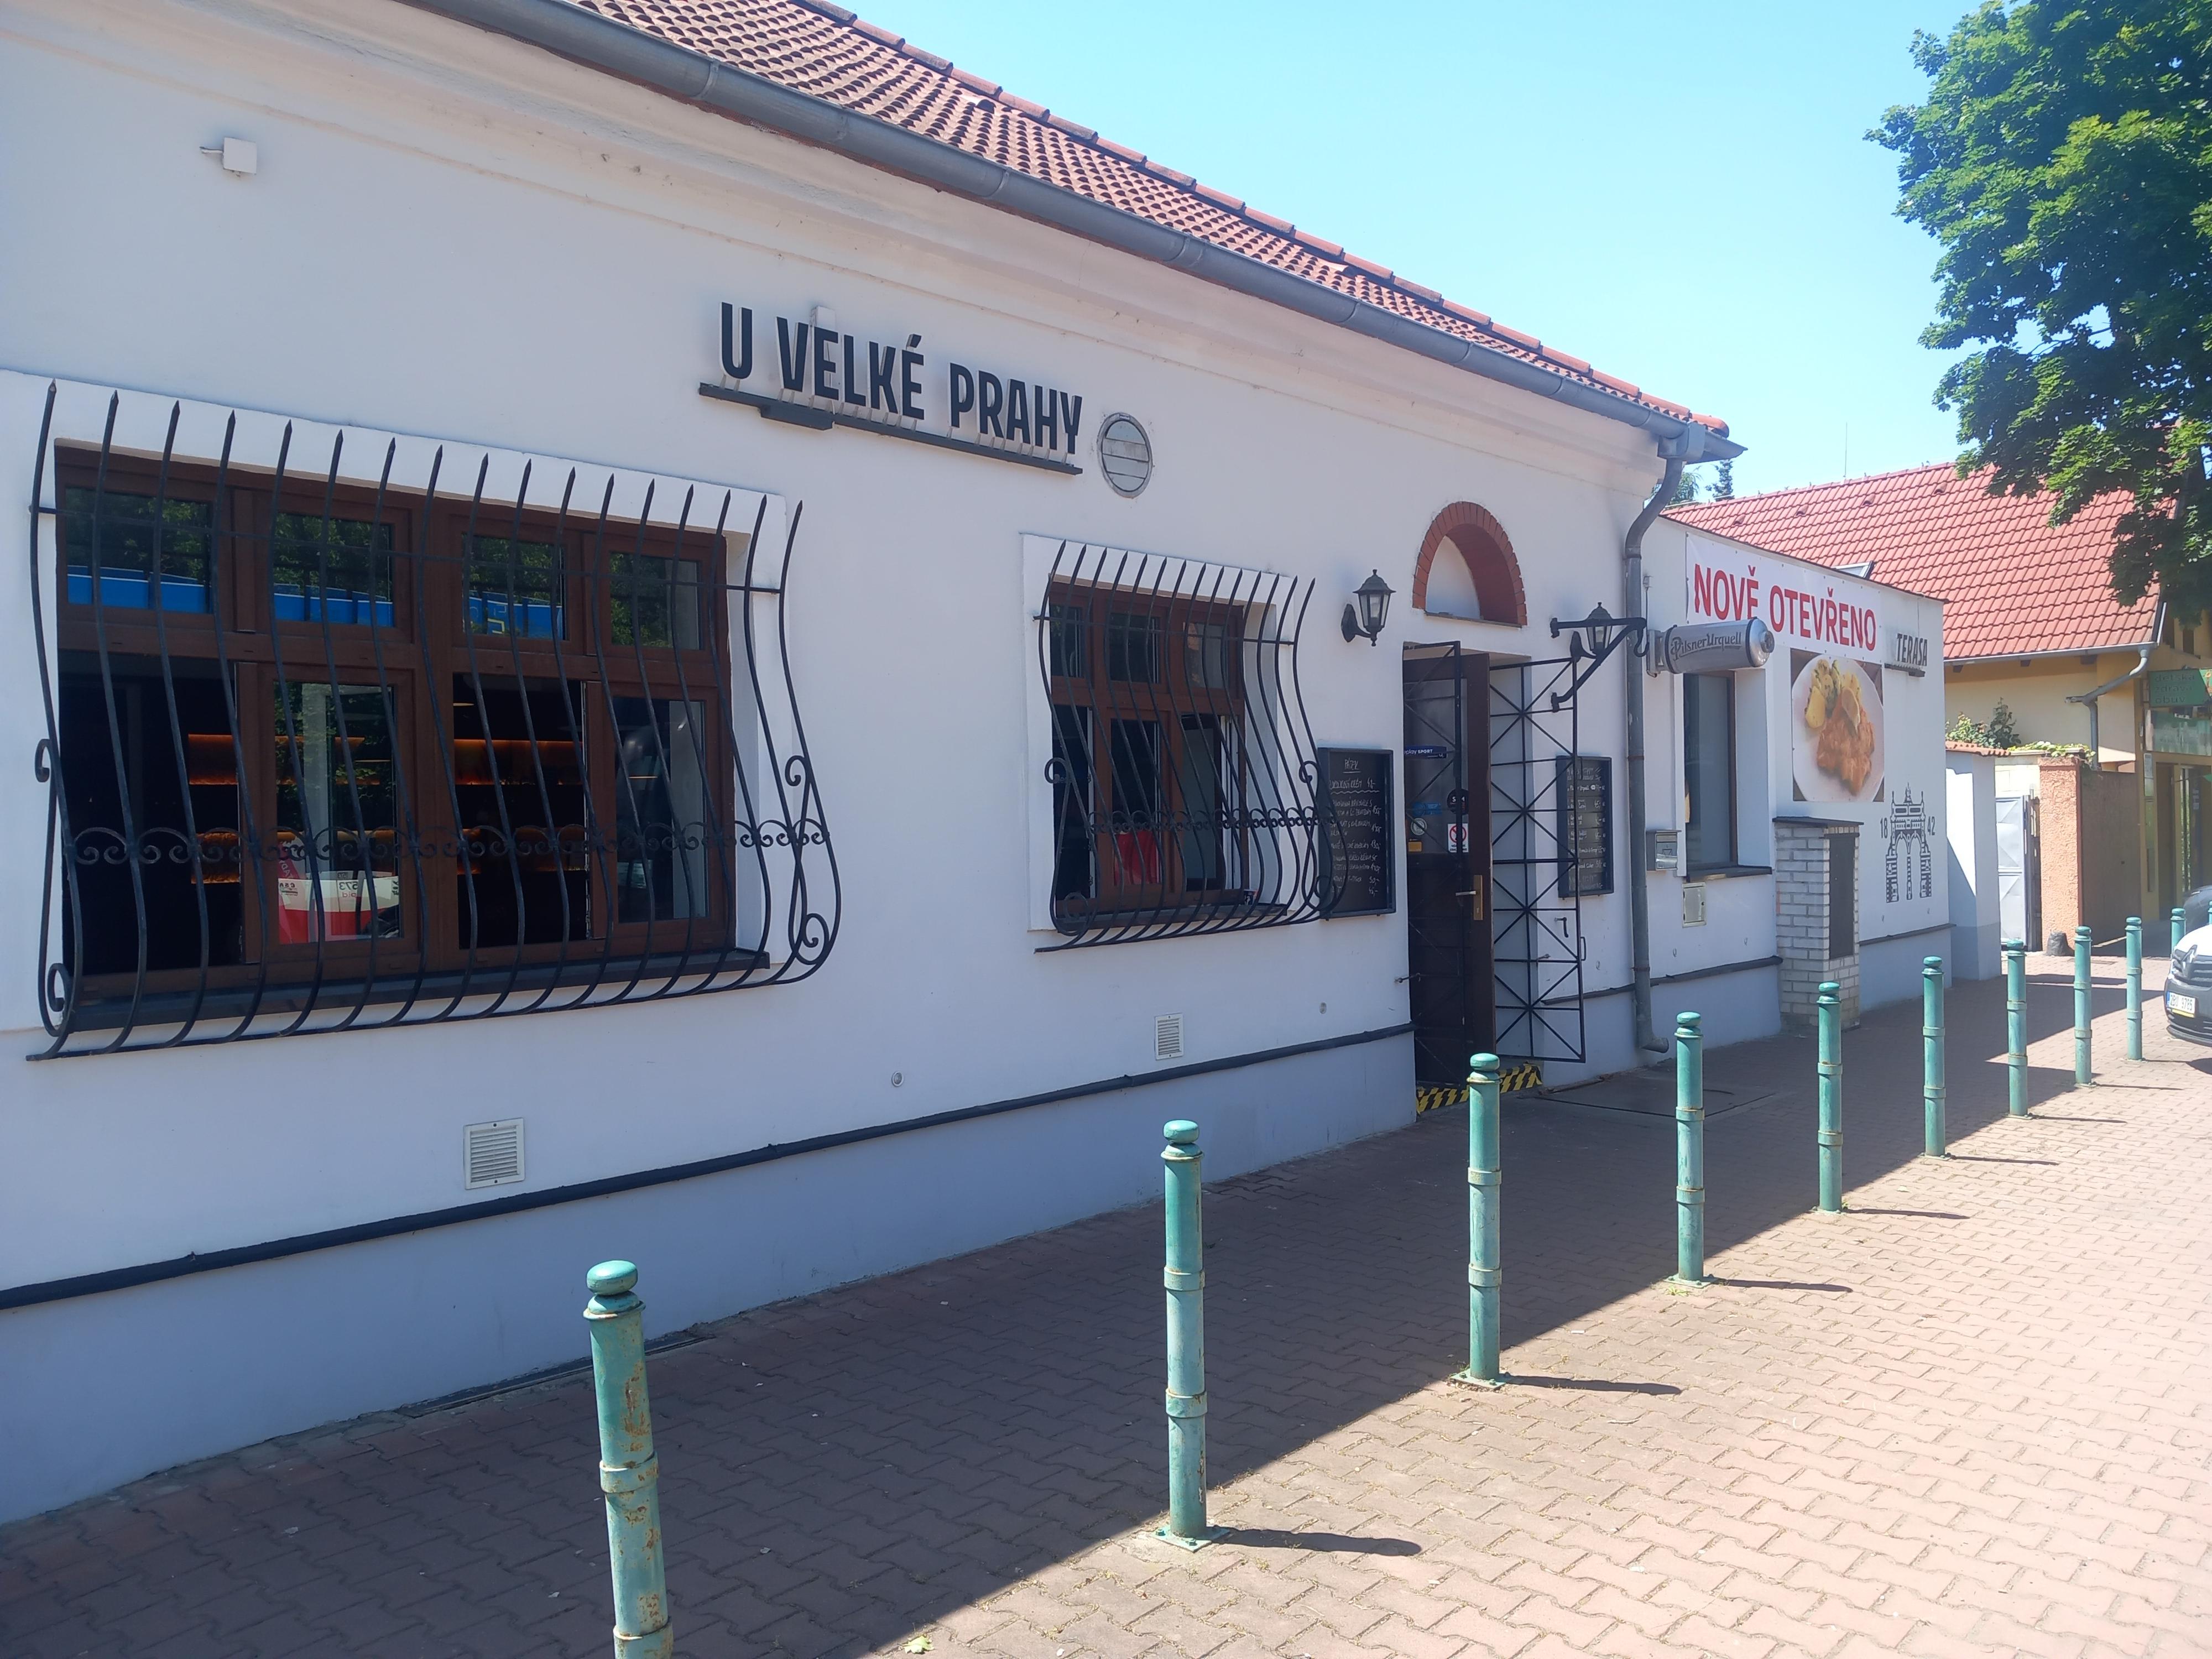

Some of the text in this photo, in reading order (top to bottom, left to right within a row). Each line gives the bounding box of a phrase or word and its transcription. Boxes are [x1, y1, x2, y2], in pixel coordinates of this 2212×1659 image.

[720, 301, 1083, 455] U VELKÉ PRAHY
[1694, 563, 1876, 651] NOVĚ OTEVŘENO
[1671, 632, 1742, 661] Pilsner Urquell
[1897, 632, 1928, 666] TERASA
[2155, 694, 2185, 704] obuv
[1880, 817, 1888, 838] 18
[1927, 816, 1936, 836] 42
